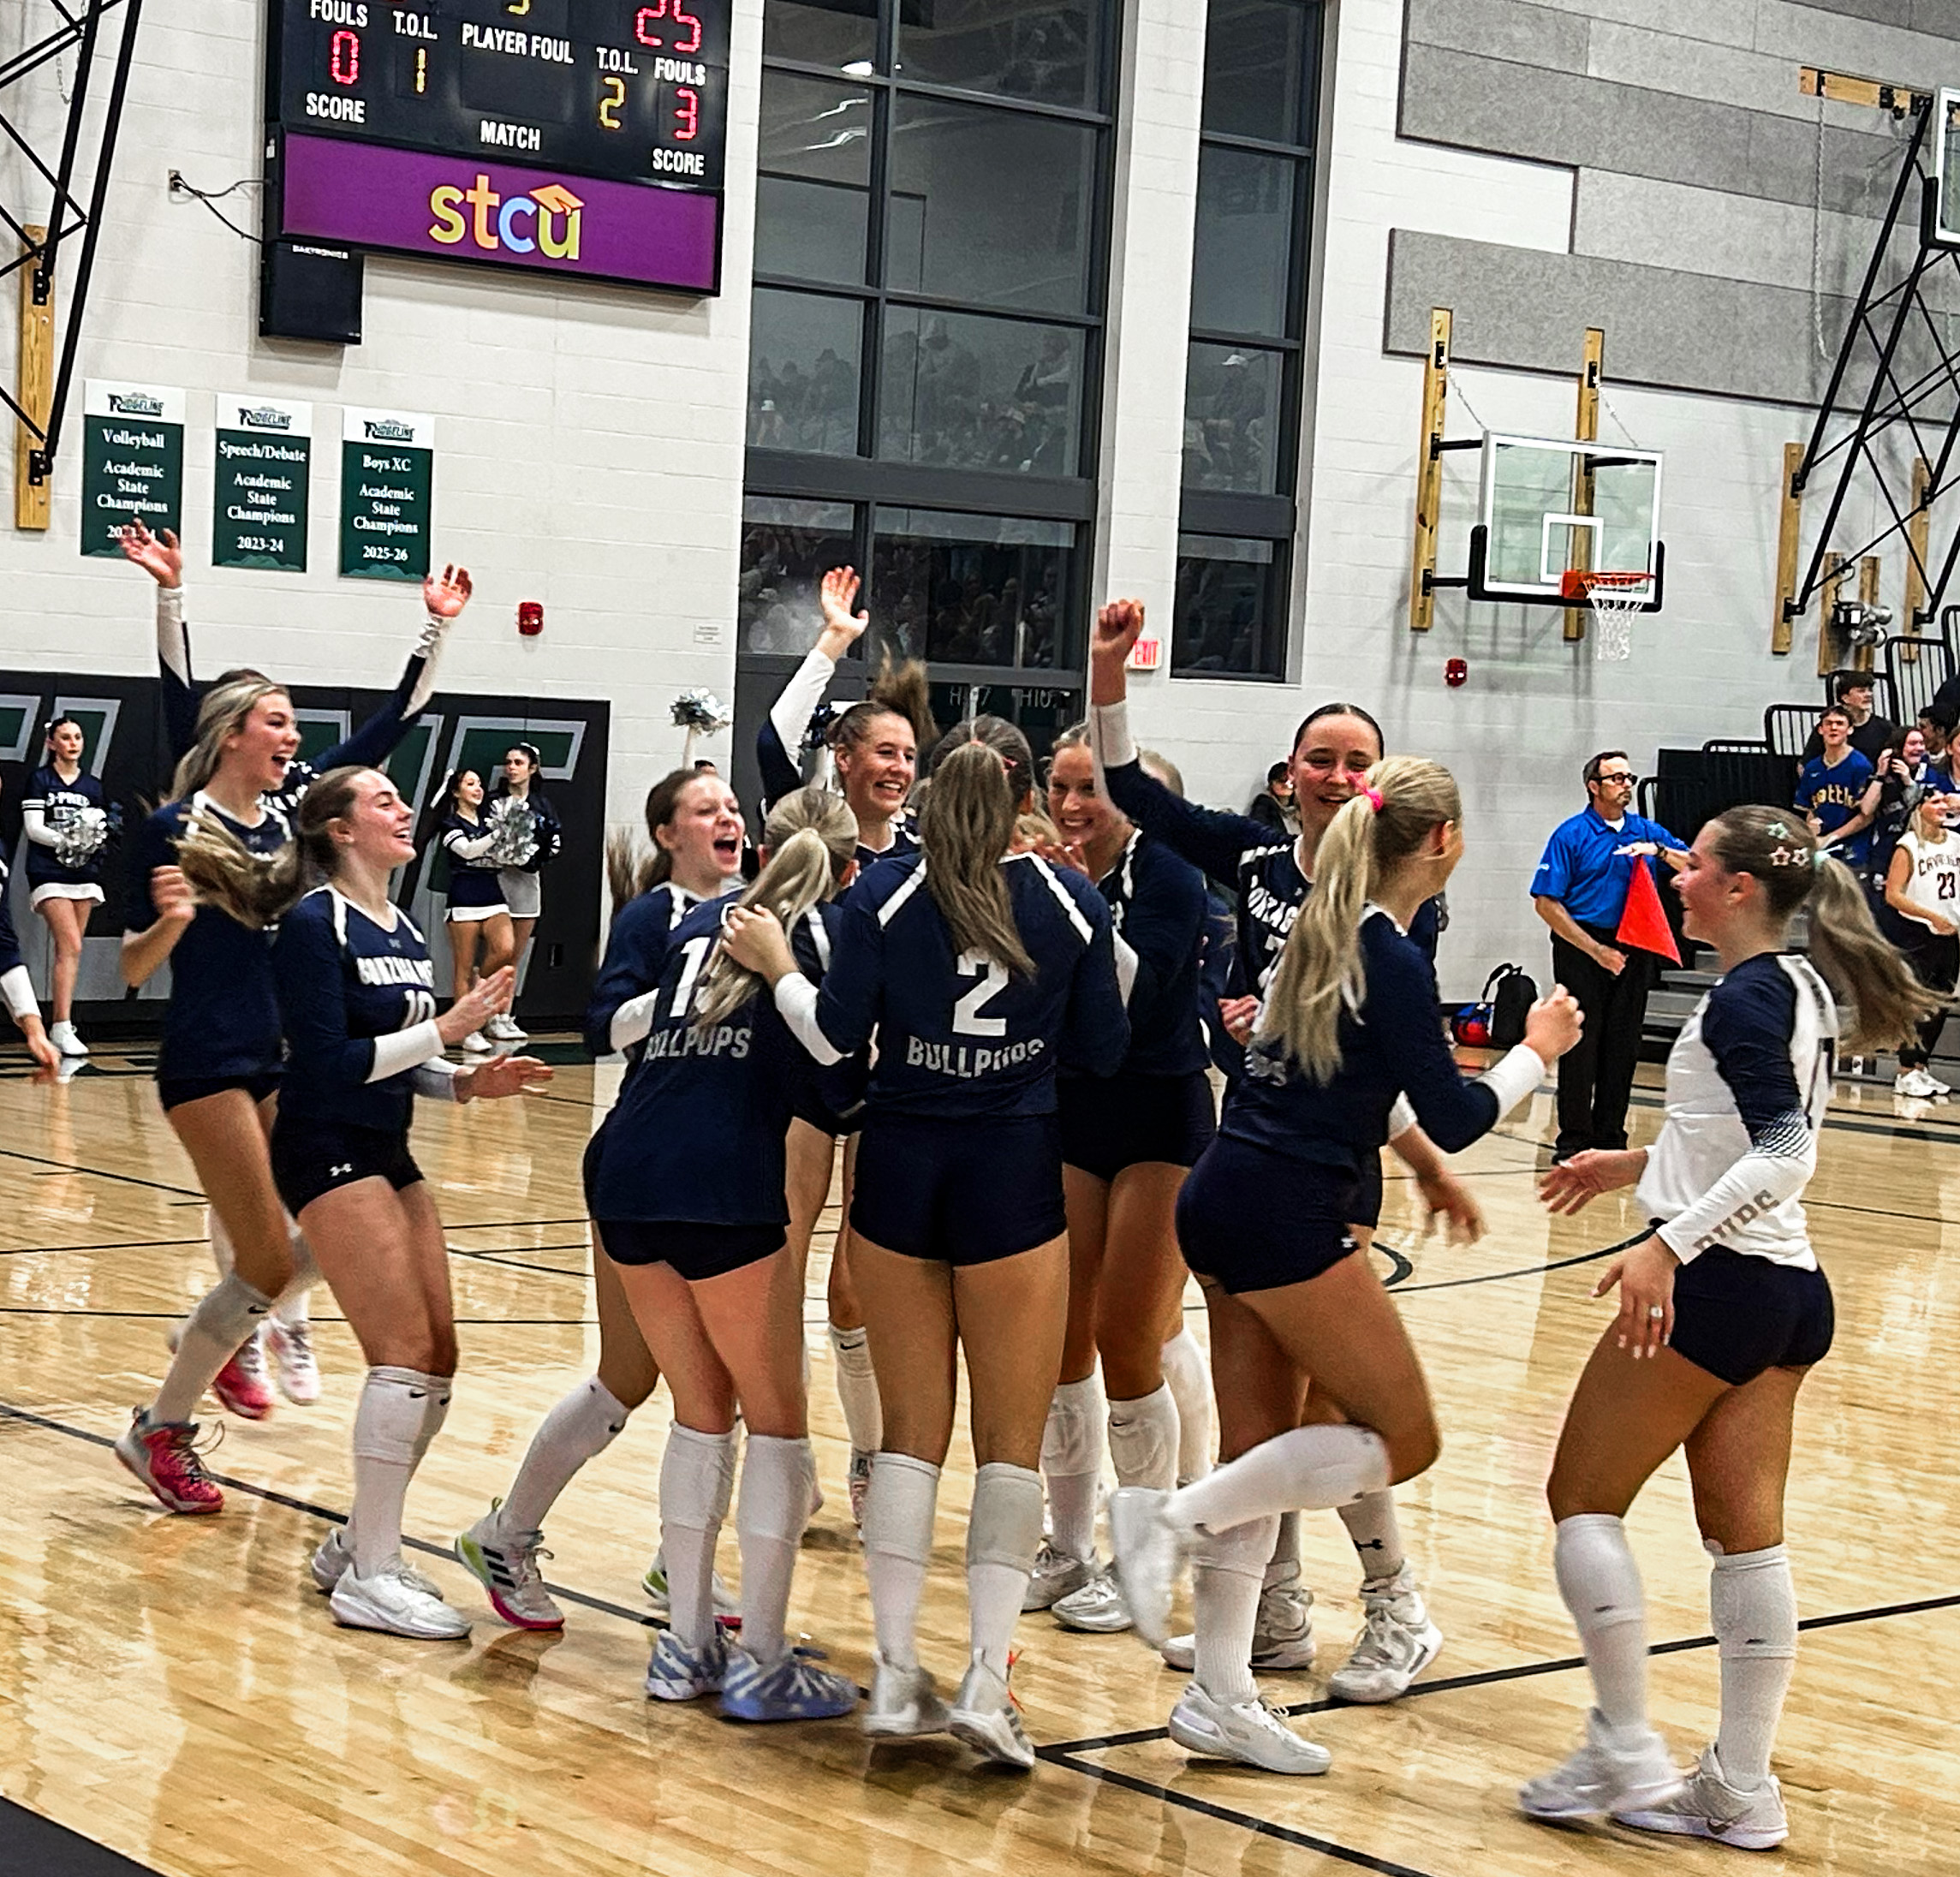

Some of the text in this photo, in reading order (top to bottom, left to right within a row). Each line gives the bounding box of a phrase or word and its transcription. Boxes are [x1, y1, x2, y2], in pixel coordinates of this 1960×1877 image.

[310, 0, 368, 27] FOULS
[393, 10, 438, 39] T.O.L.
[635, 0, 701, 51] 25
[462, 23, 575, 64] PLAYER FOUL
[331, 30, 359, 85] 0
[416, 47, 426, 92] 1
[596, 47, 640, 74] T.O.L.
[653, 57, 706, 86] FOULS
[306, 92, 366, 123] SCORE
[599, 76, 626, 129] 2
[674, 87, 699, 140] 3
[480, 120, 541, 151] MATCH
[652, 148, 705, 176] SCORE
[429, 174, 585, 260] stcu
[102, 427, 165, 450] Volleyball
[218, 440, 307, 463] Speech/Debate
[103, 459, 164, 479] Academic
[362, 454, 412, 474] Boys XC
[117, 478, 150, 495] State
[233, 472, 292, 491] Academic
[359, 483, 415, 502] Academic
[96, 493, 169, 515] Champions
[247, 490, 277, 506] State
[372, 501, 401, 517] State
[227, 505, 296, 527] Champions
[353, 515, 420, 536] Champions
[235, 535, 284, 553] 2023-24
[362, 545, 409, 562] 2025-26
[1135, 640, 1158, 665] EXIT
[1937, 871, 1957, 900] 23
[952, 946, 1009, 1037] 2
